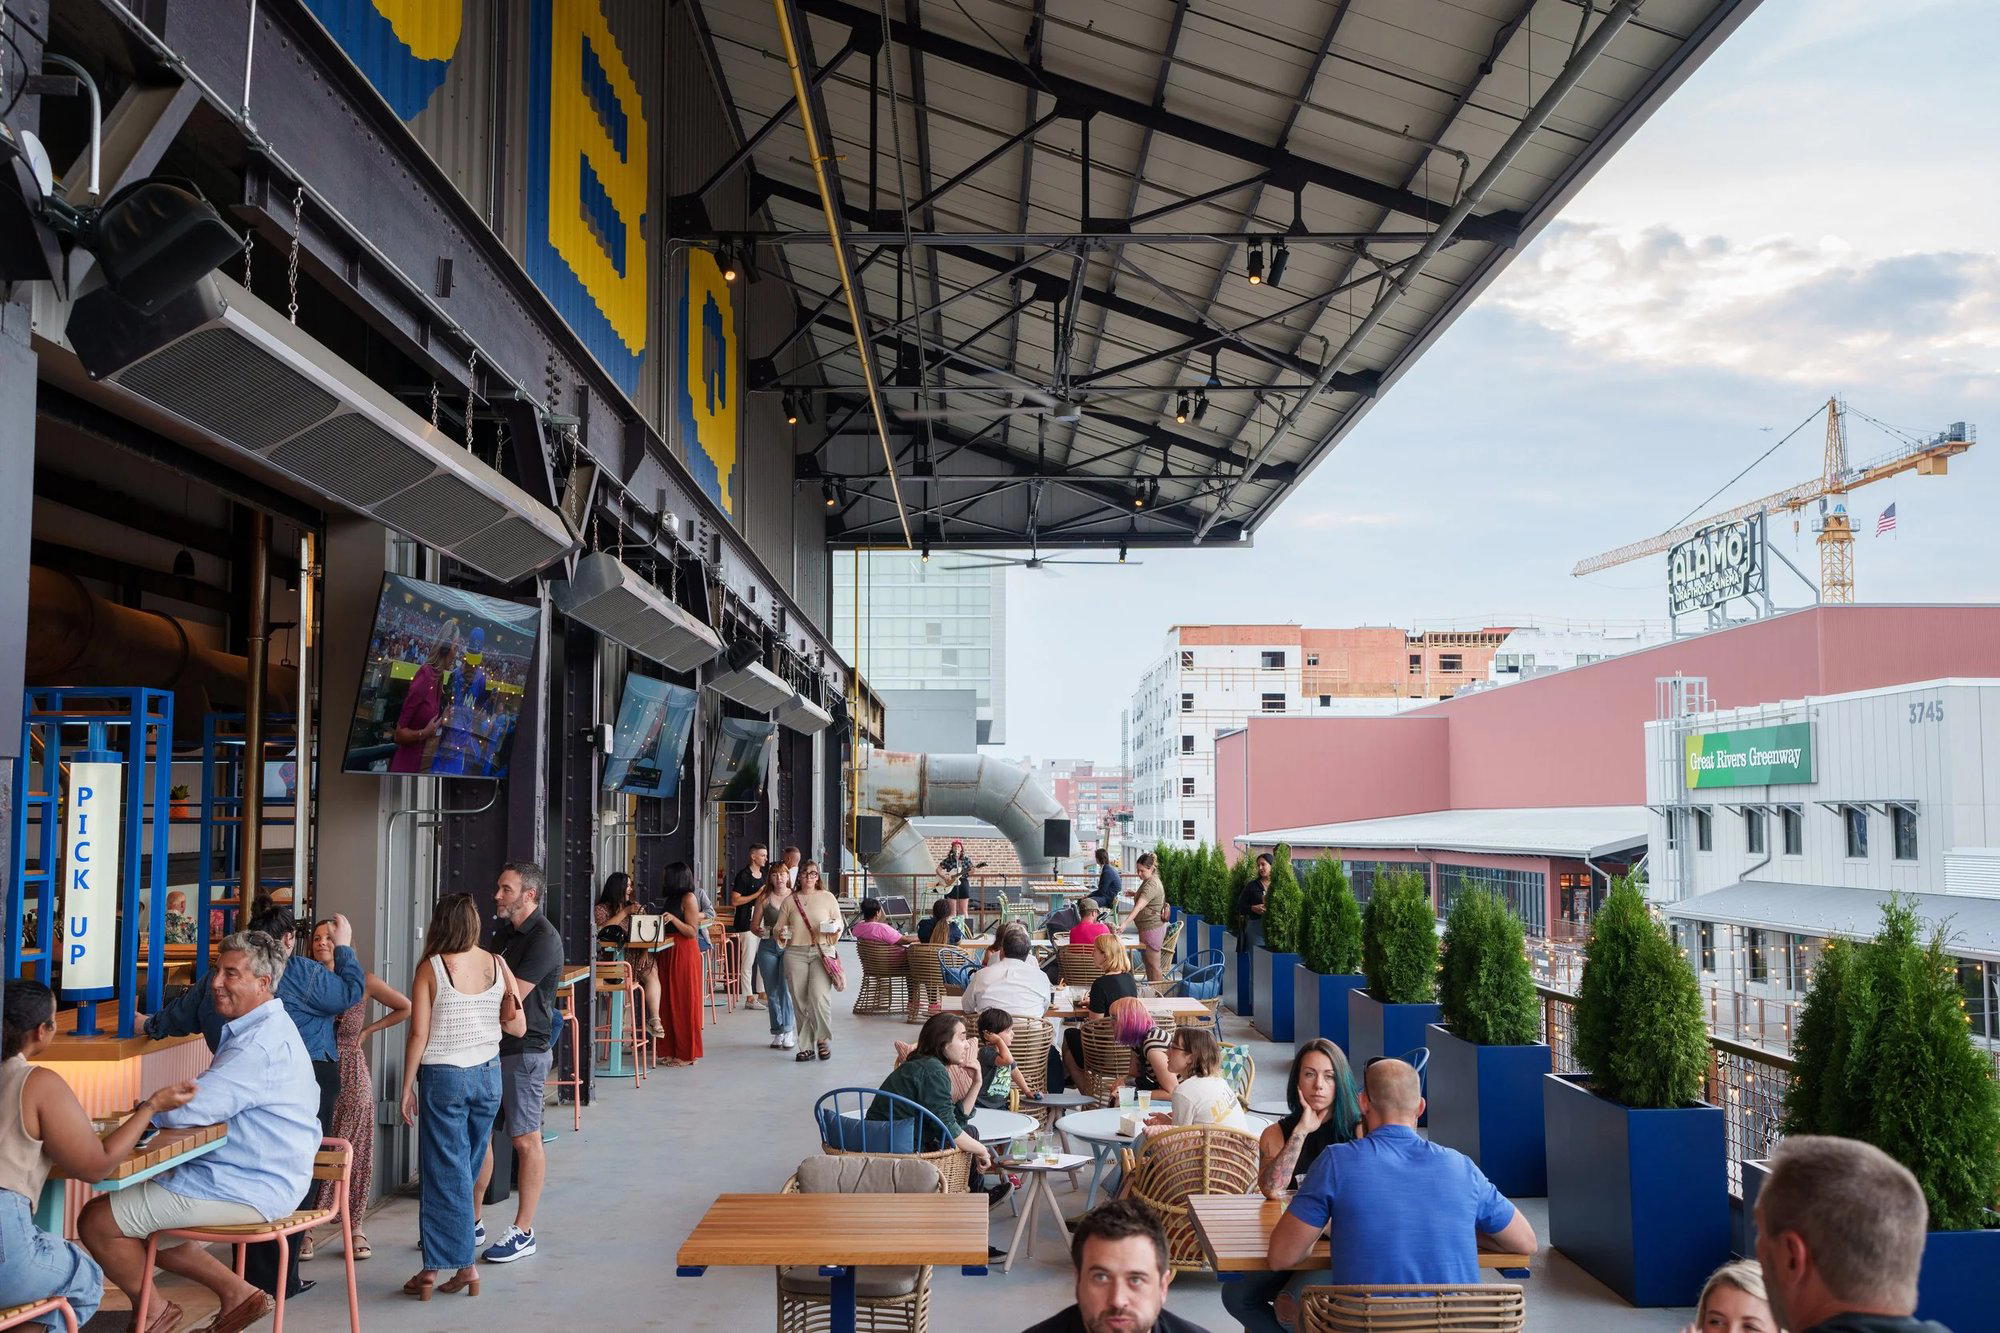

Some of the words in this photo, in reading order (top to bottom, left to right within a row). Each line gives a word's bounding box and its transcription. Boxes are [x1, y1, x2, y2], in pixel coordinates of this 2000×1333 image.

[1672, 532, 1743, 587] ALAMO
[1675, 580, 1713, 603] DRAFTHOUSE
[1713, 570, 1740, 591] CINEMA
[1909, 700, 1944, 724] 3745
[1690, 752, 1715, 770] Great
[1717, 749, 1746, 768] Rivers
[1749, 747, 1802, 769] Greenway
[73, 786, 93, 890] PICK
[70, 916, 87, 965] UP
